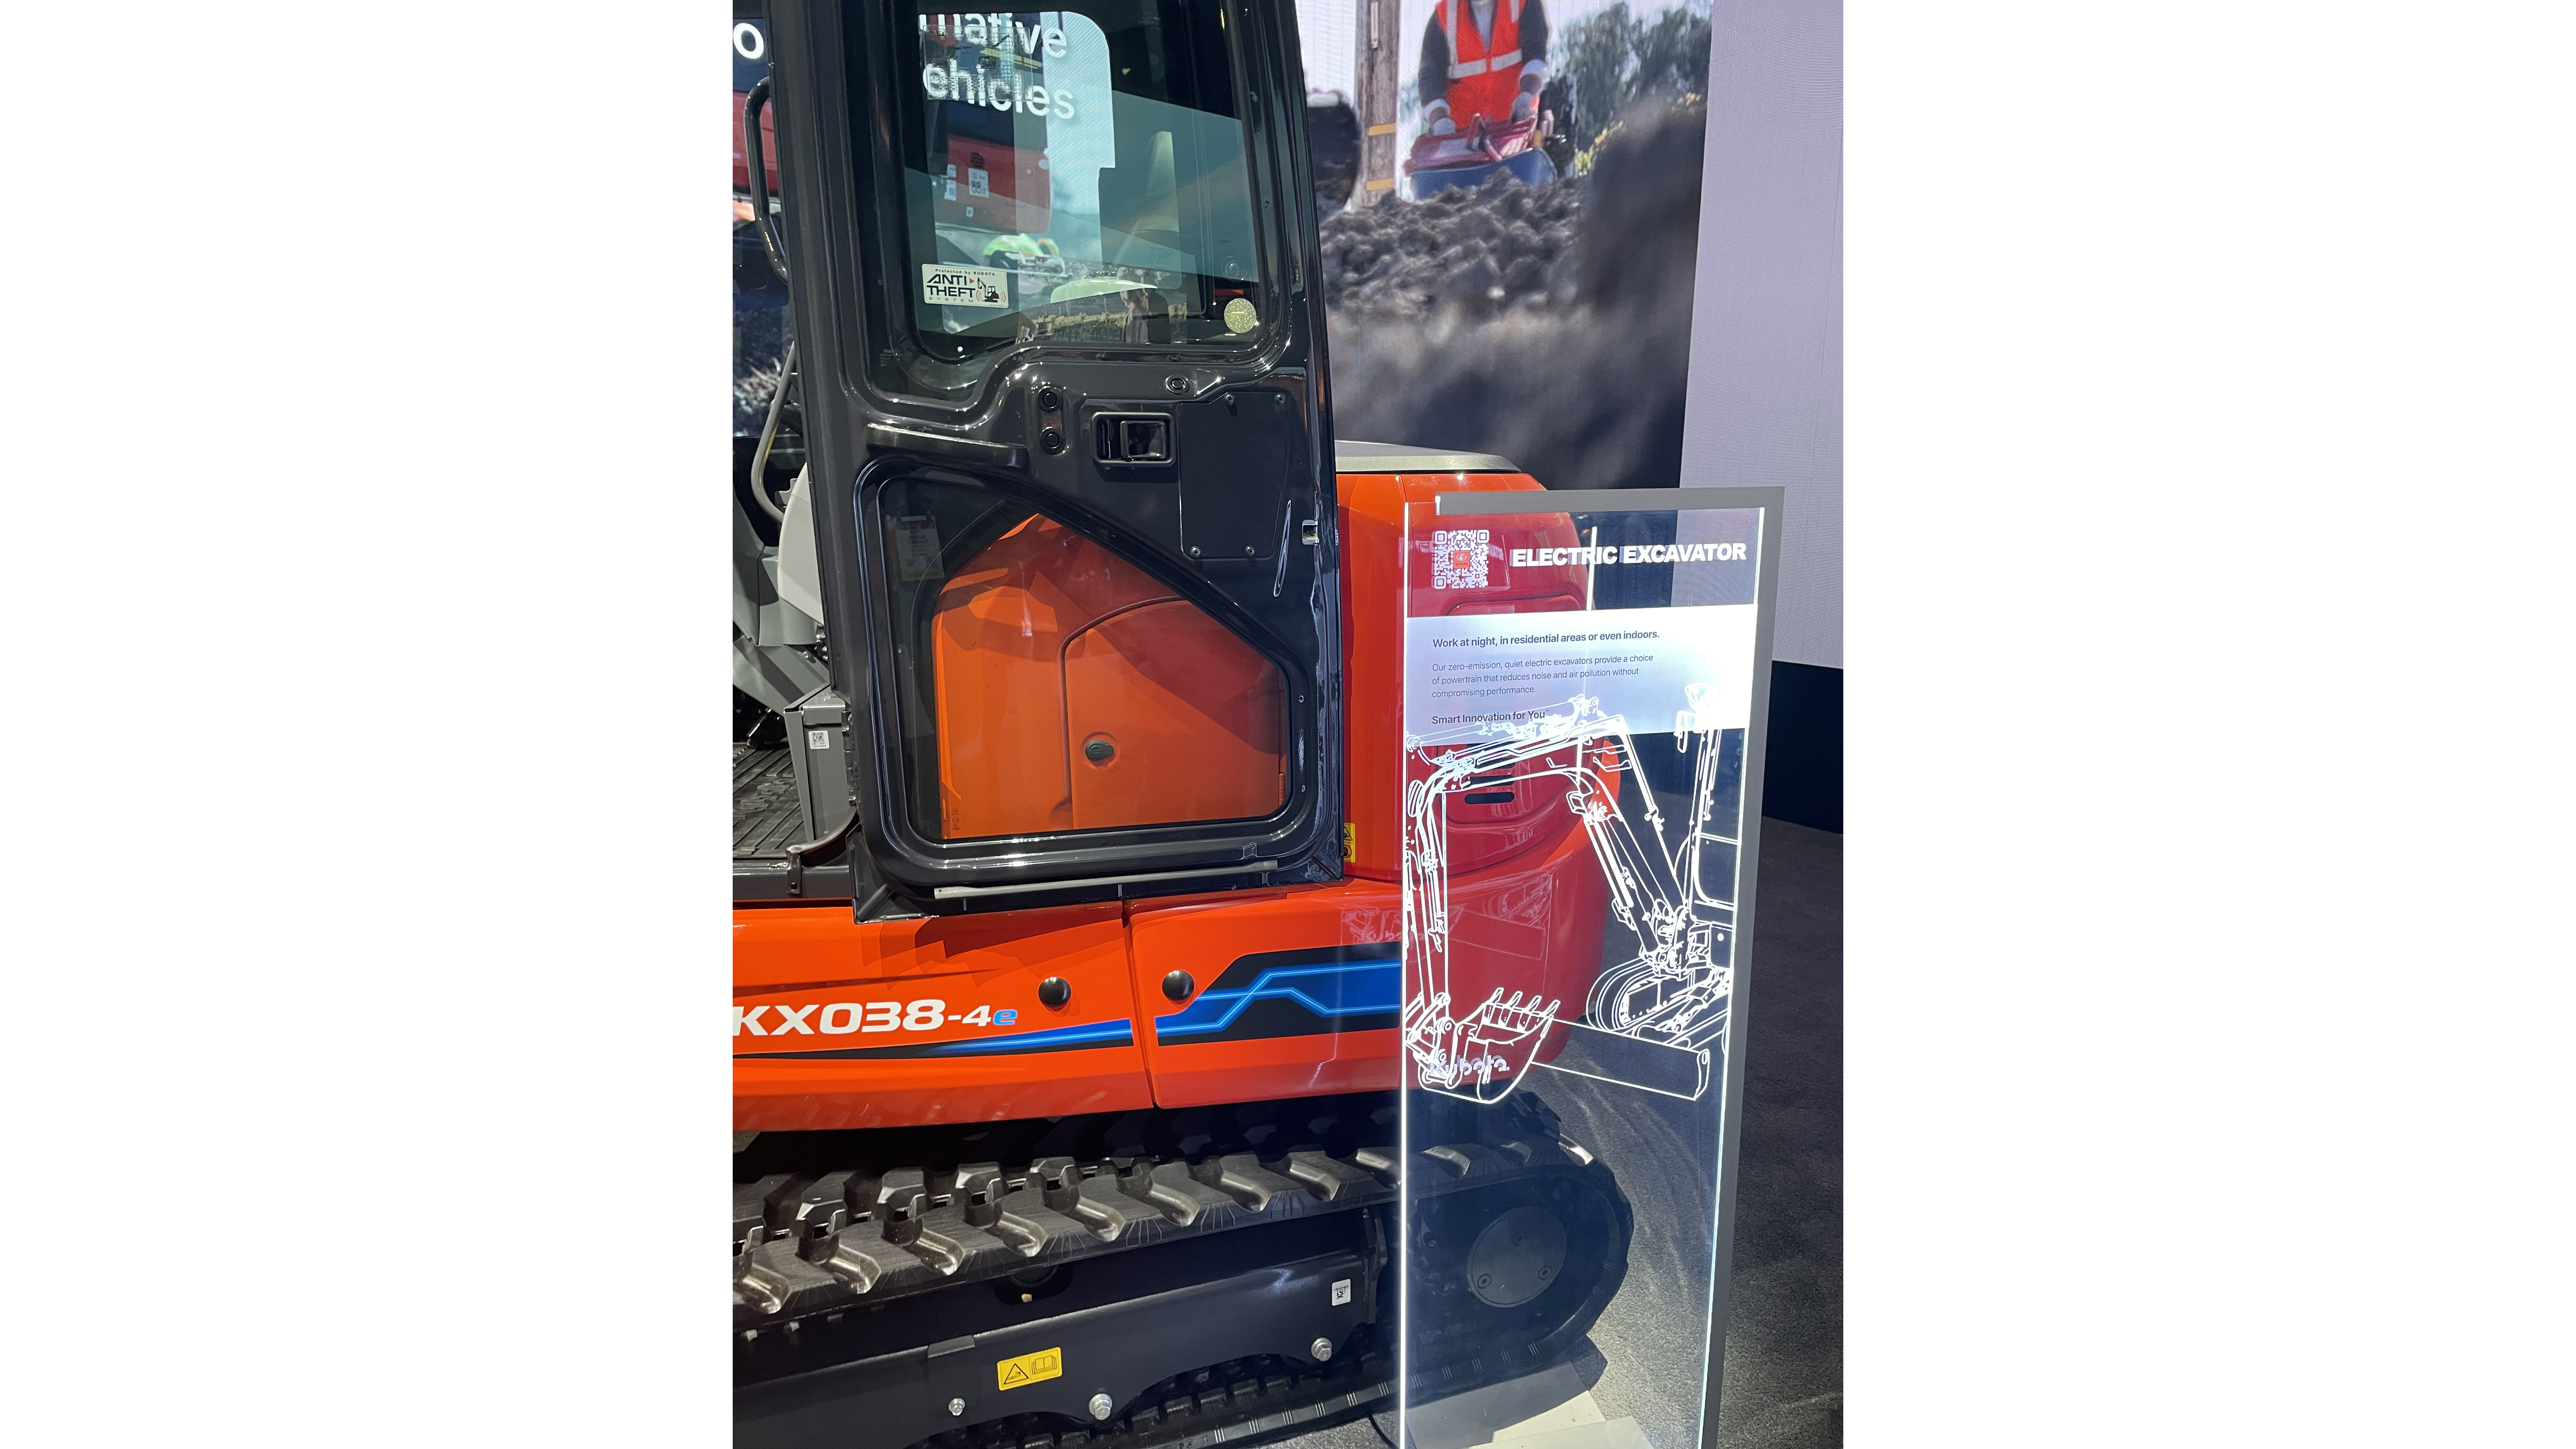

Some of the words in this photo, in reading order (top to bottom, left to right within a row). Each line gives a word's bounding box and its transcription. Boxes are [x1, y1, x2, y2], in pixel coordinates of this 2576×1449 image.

[927, 274, 967, 285] ANTI
[927, 285, 975, 298] THEFT
[1512, 546, 1618, 567] ELECTRIC
[1623, 543, 1746, 564] EXCAVATOR
[1433, 638, 1458, 647] Work
[1471, 637, 1498, 648] night,
[1500, 636, 1508, 645] in
[1511, 634, 1559, 644] residential
[1623, 631, 1659, 639] indoors.
[1448, 662, 1503, 671] zero-emission,
[1505, 660, 1523, 670] quiet
[1525, 658, 1552, 667] electric
[1554, 657, 1593, 666] excavators
[1594, 656, 1621, 665] provide
[1442, 675, 1482, 686] powertrain
[1580, 669, 1610, 679] pollution
[1432, 688, 1484, 698] compromising
[1487, 687, 1536, 696] performance.
[1432, 715, 1461, 724] Smart
[1463, 712, 1511, 722] Innovation
[1513, 711, 1526, 720] for
[733, 999, 1018, 1036] KX038-4e
